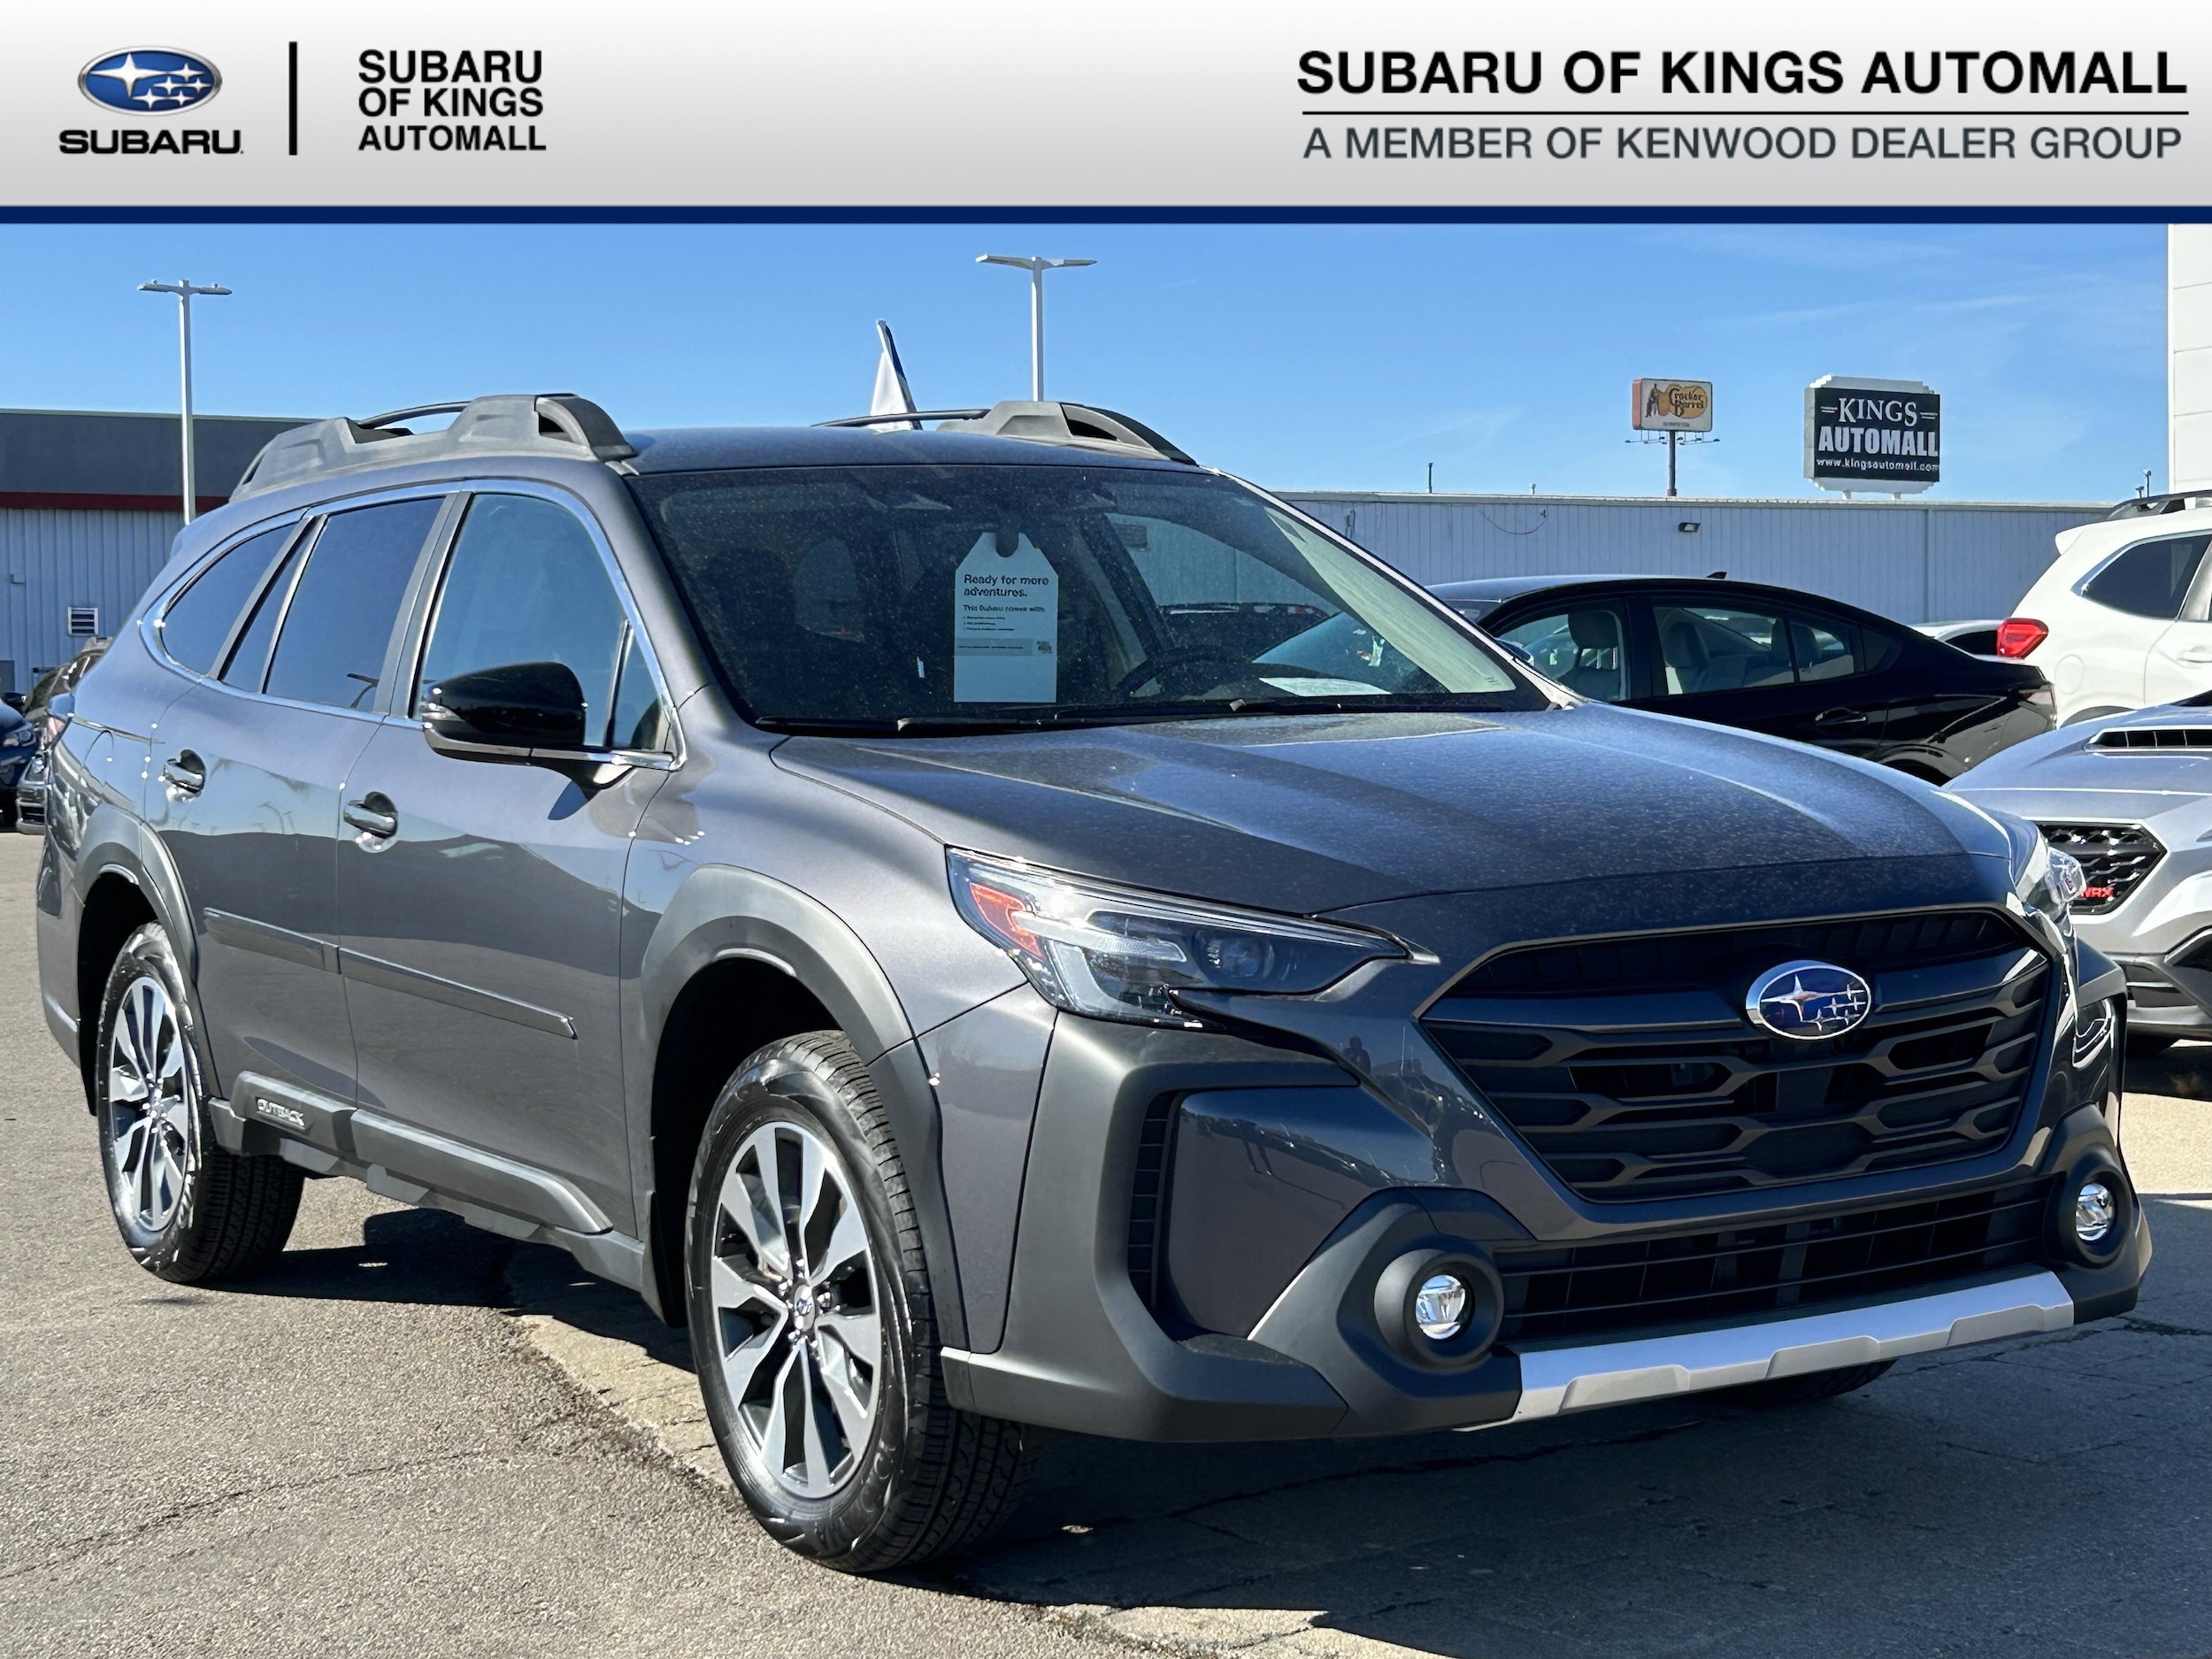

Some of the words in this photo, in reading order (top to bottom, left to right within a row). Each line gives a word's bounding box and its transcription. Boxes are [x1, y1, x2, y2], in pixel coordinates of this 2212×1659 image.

[1839, 397, 1918, 426] KINGS
[1818, 426, 1939, 457] AUTOMALL
[964, 574, 998, 586] Ready
[1001, 575, 1017, 585] for
[964, 587, 1027, 597] adventures.
[257, 1098, 305, 1126] OUTBACK
